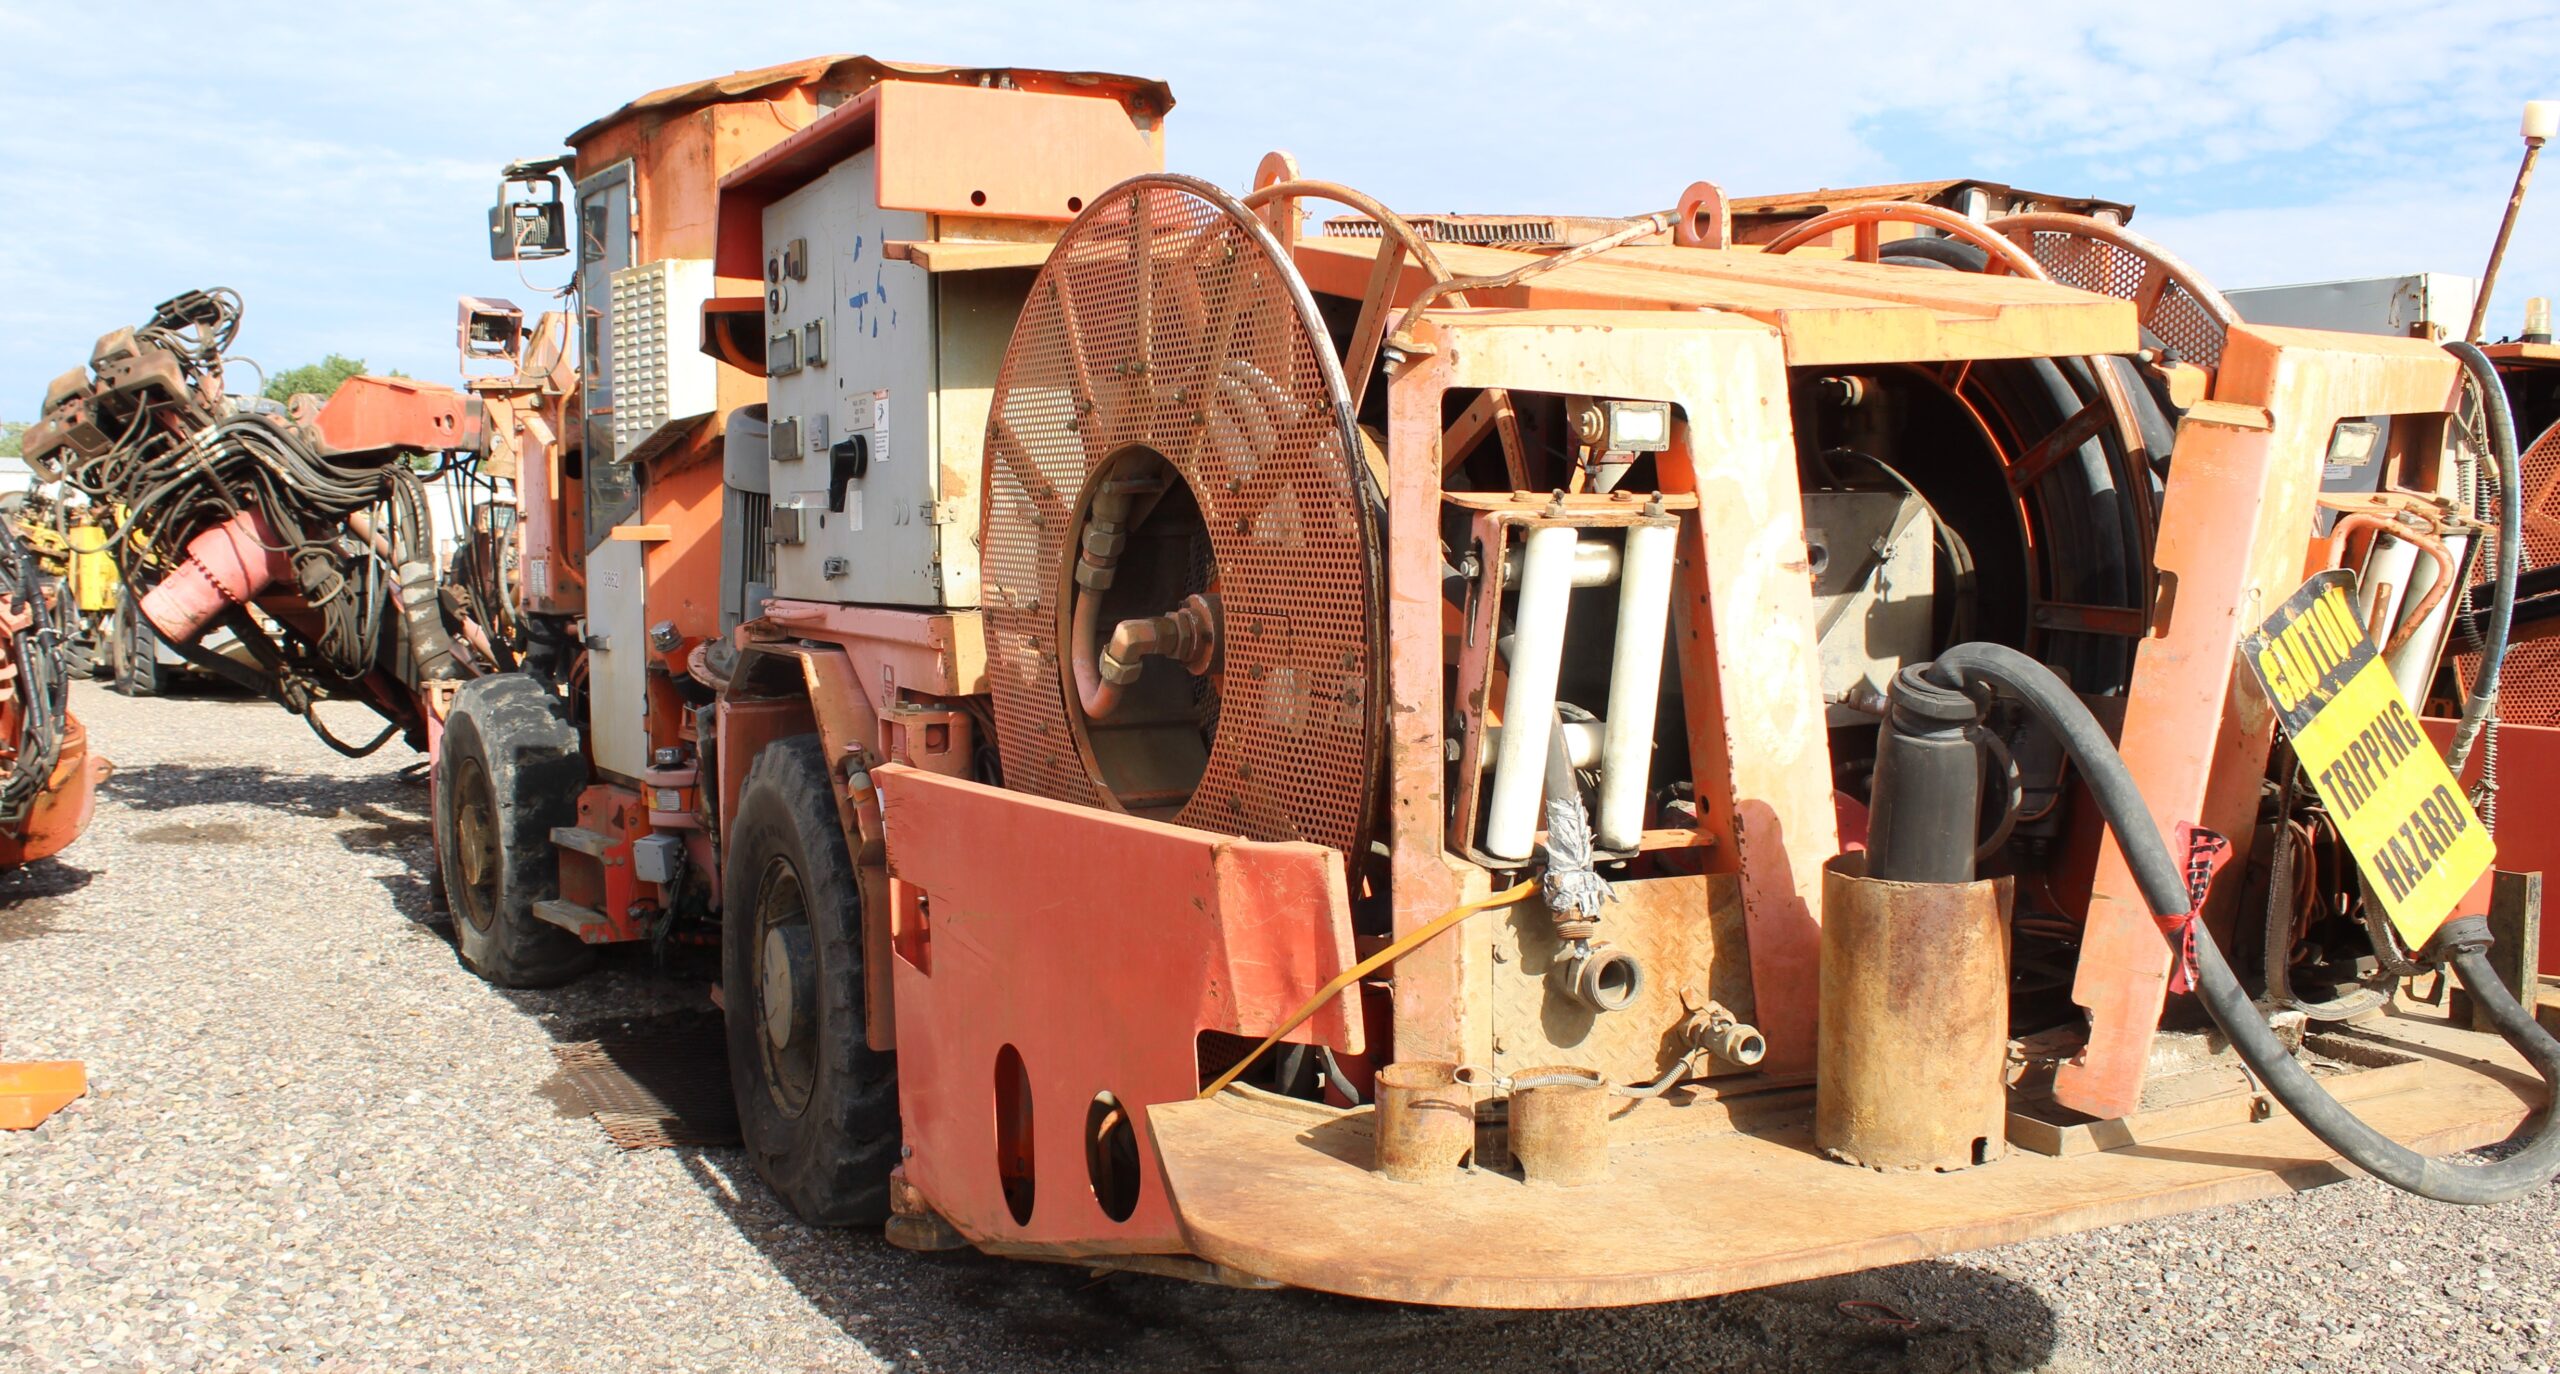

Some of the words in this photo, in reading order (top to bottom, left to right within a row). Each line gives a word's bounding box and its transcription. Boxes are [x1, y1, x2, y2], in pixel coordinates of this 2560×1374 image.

[2258, 586, 2363, 713] CAUTION
[2319, 699, 2420, 821] TRIPPING
[2373, 784, 2467, 904] HAZARD
